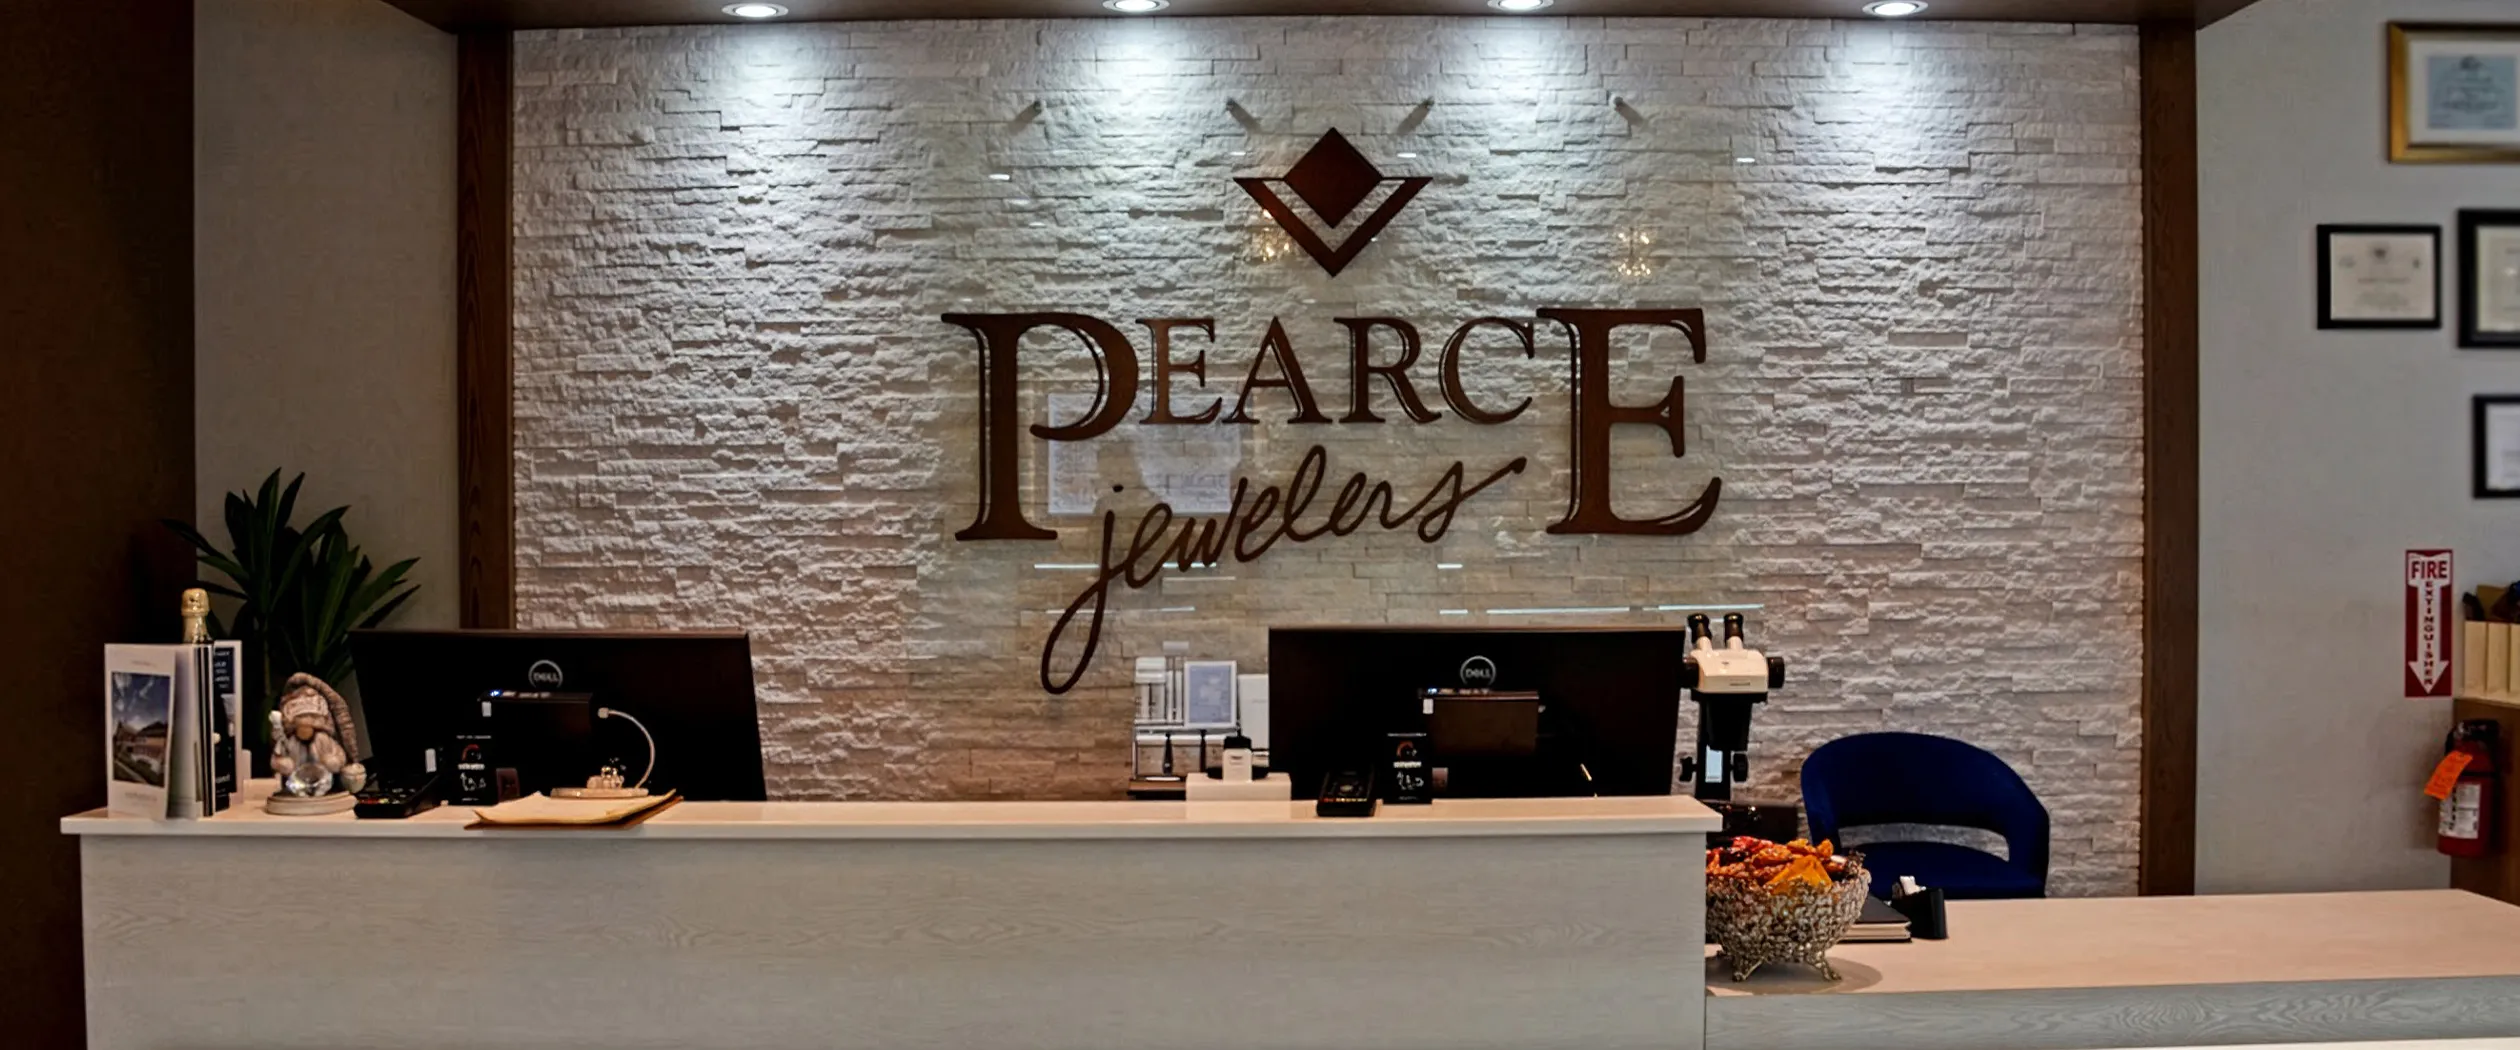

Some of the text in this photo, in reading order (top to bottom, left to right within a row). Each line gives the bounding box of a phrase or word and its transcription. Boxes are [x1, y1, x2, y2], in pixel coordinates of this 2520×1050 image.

[941, 307, 1721, 540] PEARCE
[1040, 445, 1527, 694] jewelers
[2411, 560, 2448, 579] FIRE
[2424, 581, 2434, 685] EXTINGUISHER
[533, 672, 558, 683] DELL
[1465, 668, 1491, 679] DELL
